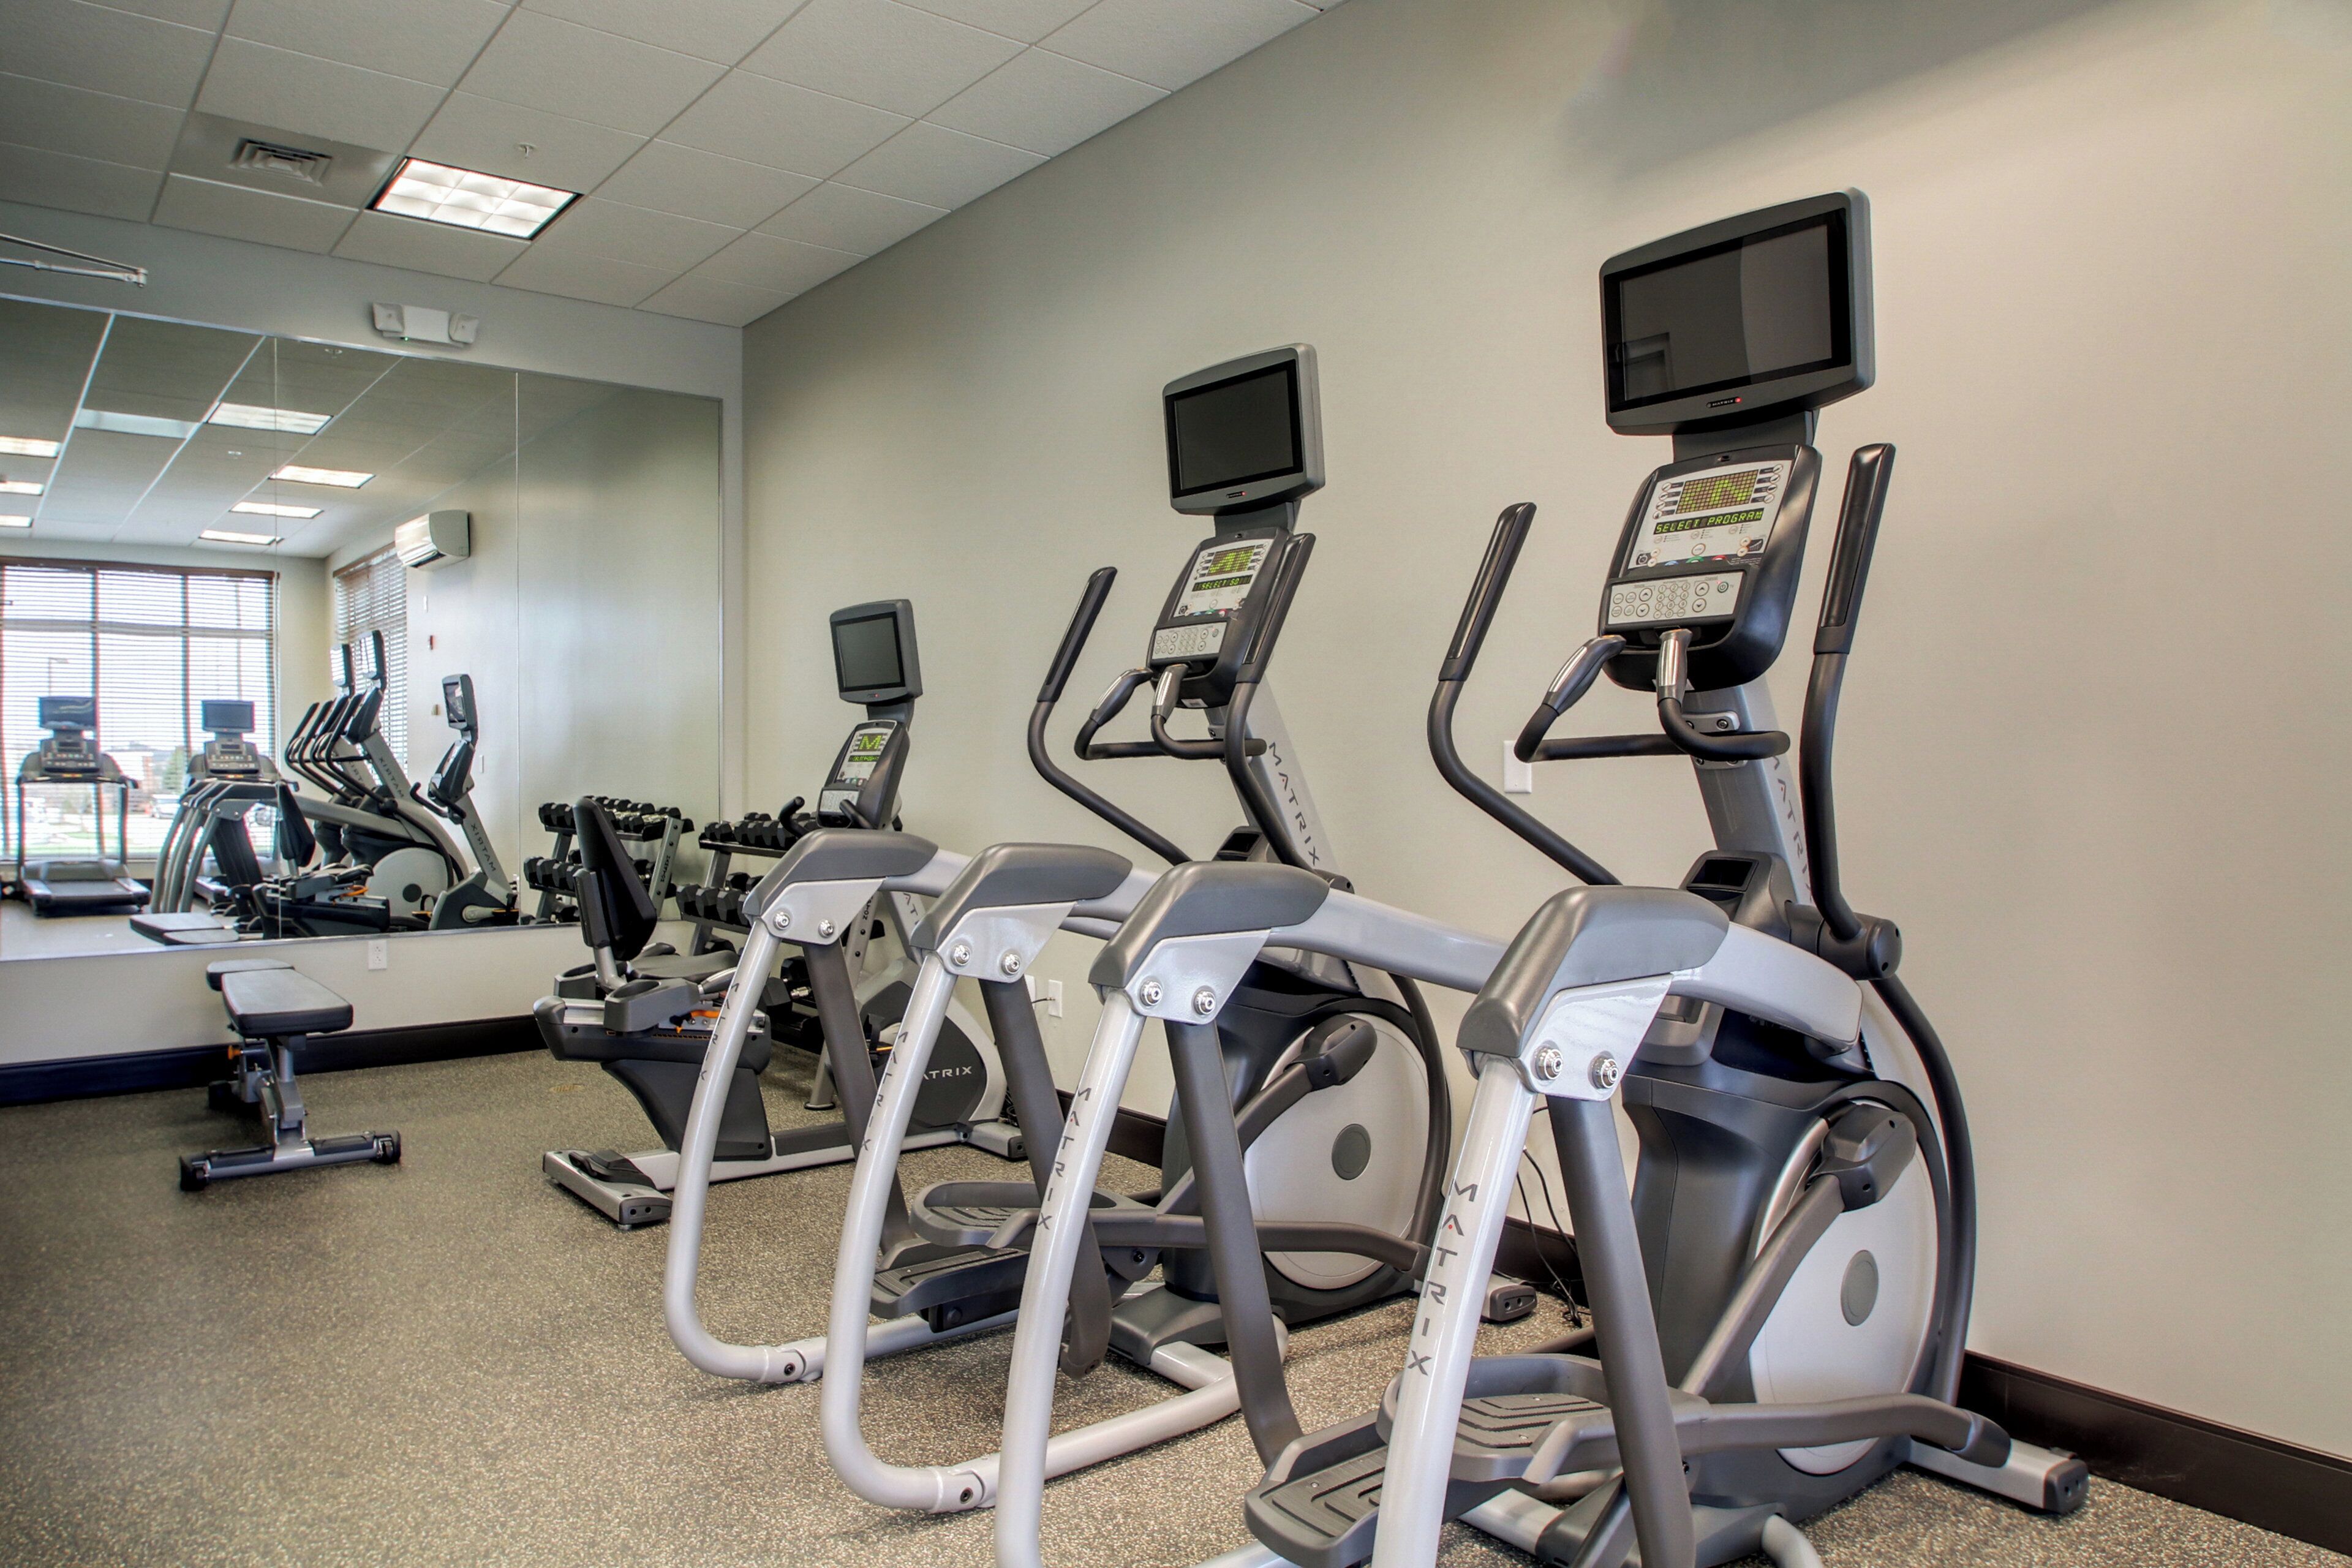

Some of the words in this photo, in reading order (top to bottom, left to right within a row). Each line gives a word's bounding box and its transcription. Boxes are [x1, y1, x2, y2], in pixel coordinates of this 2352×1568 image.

[1202, 579, 1227, 589] SELECT
[1655, 519, 1700, 533] SELECT
[1707, 511, 1763, 526] PROGRAM
[1269, 742, 1320, 866] MATRIX
[1038, 1087, 1091, 1230] MATRIX
[1408, 1178, 1477, 1376] MATRIX
